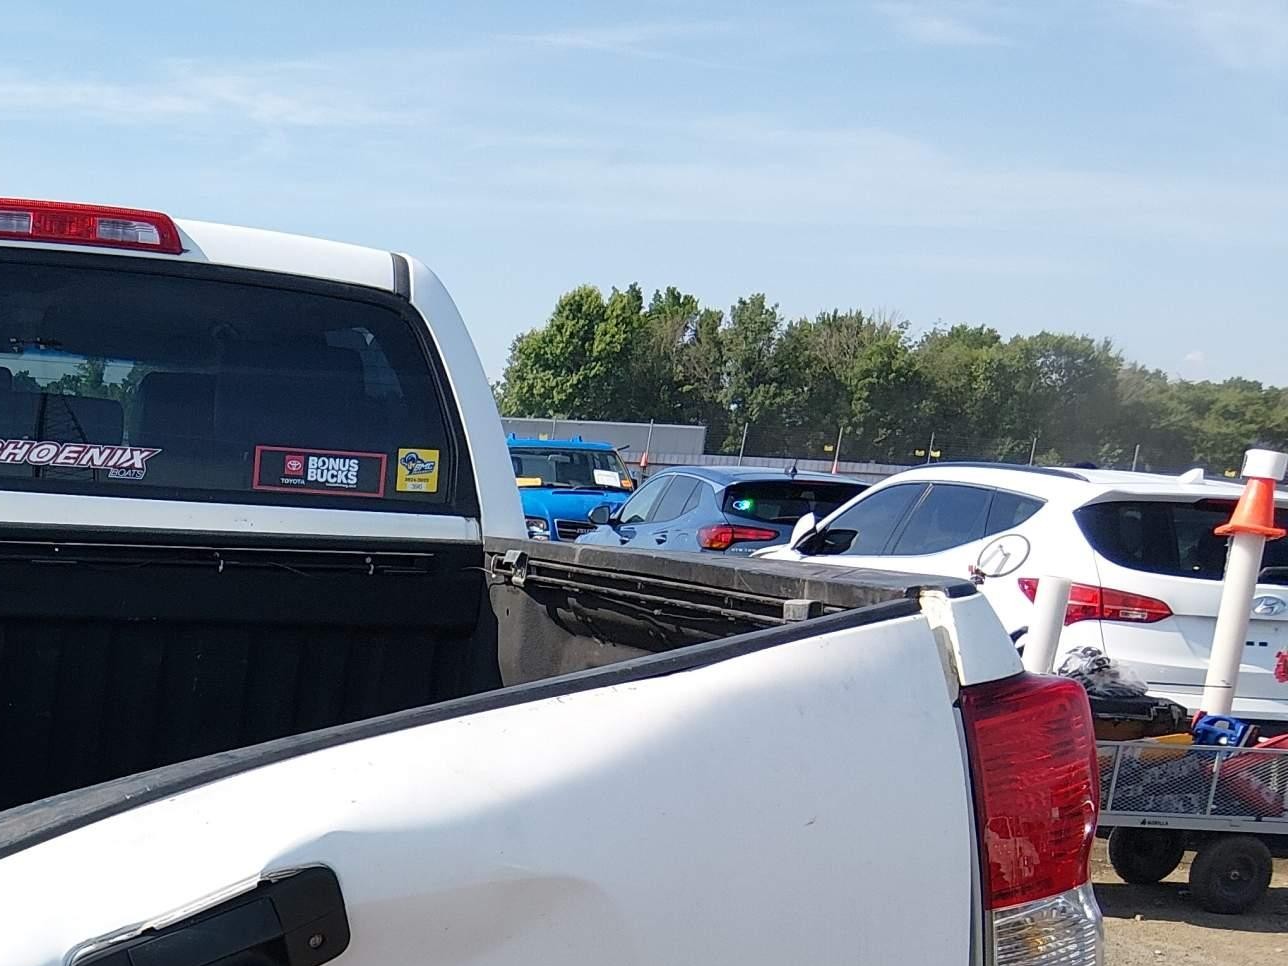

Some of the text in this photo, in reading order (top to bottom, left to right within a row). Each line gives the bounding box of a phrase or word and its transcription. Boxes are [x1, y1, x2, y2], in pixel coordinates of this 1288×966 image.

[309, 456, 359, 472] BONUS
[110, 468, 144, 479] BOATS
[307, 468, 357, 484] BUCKS
